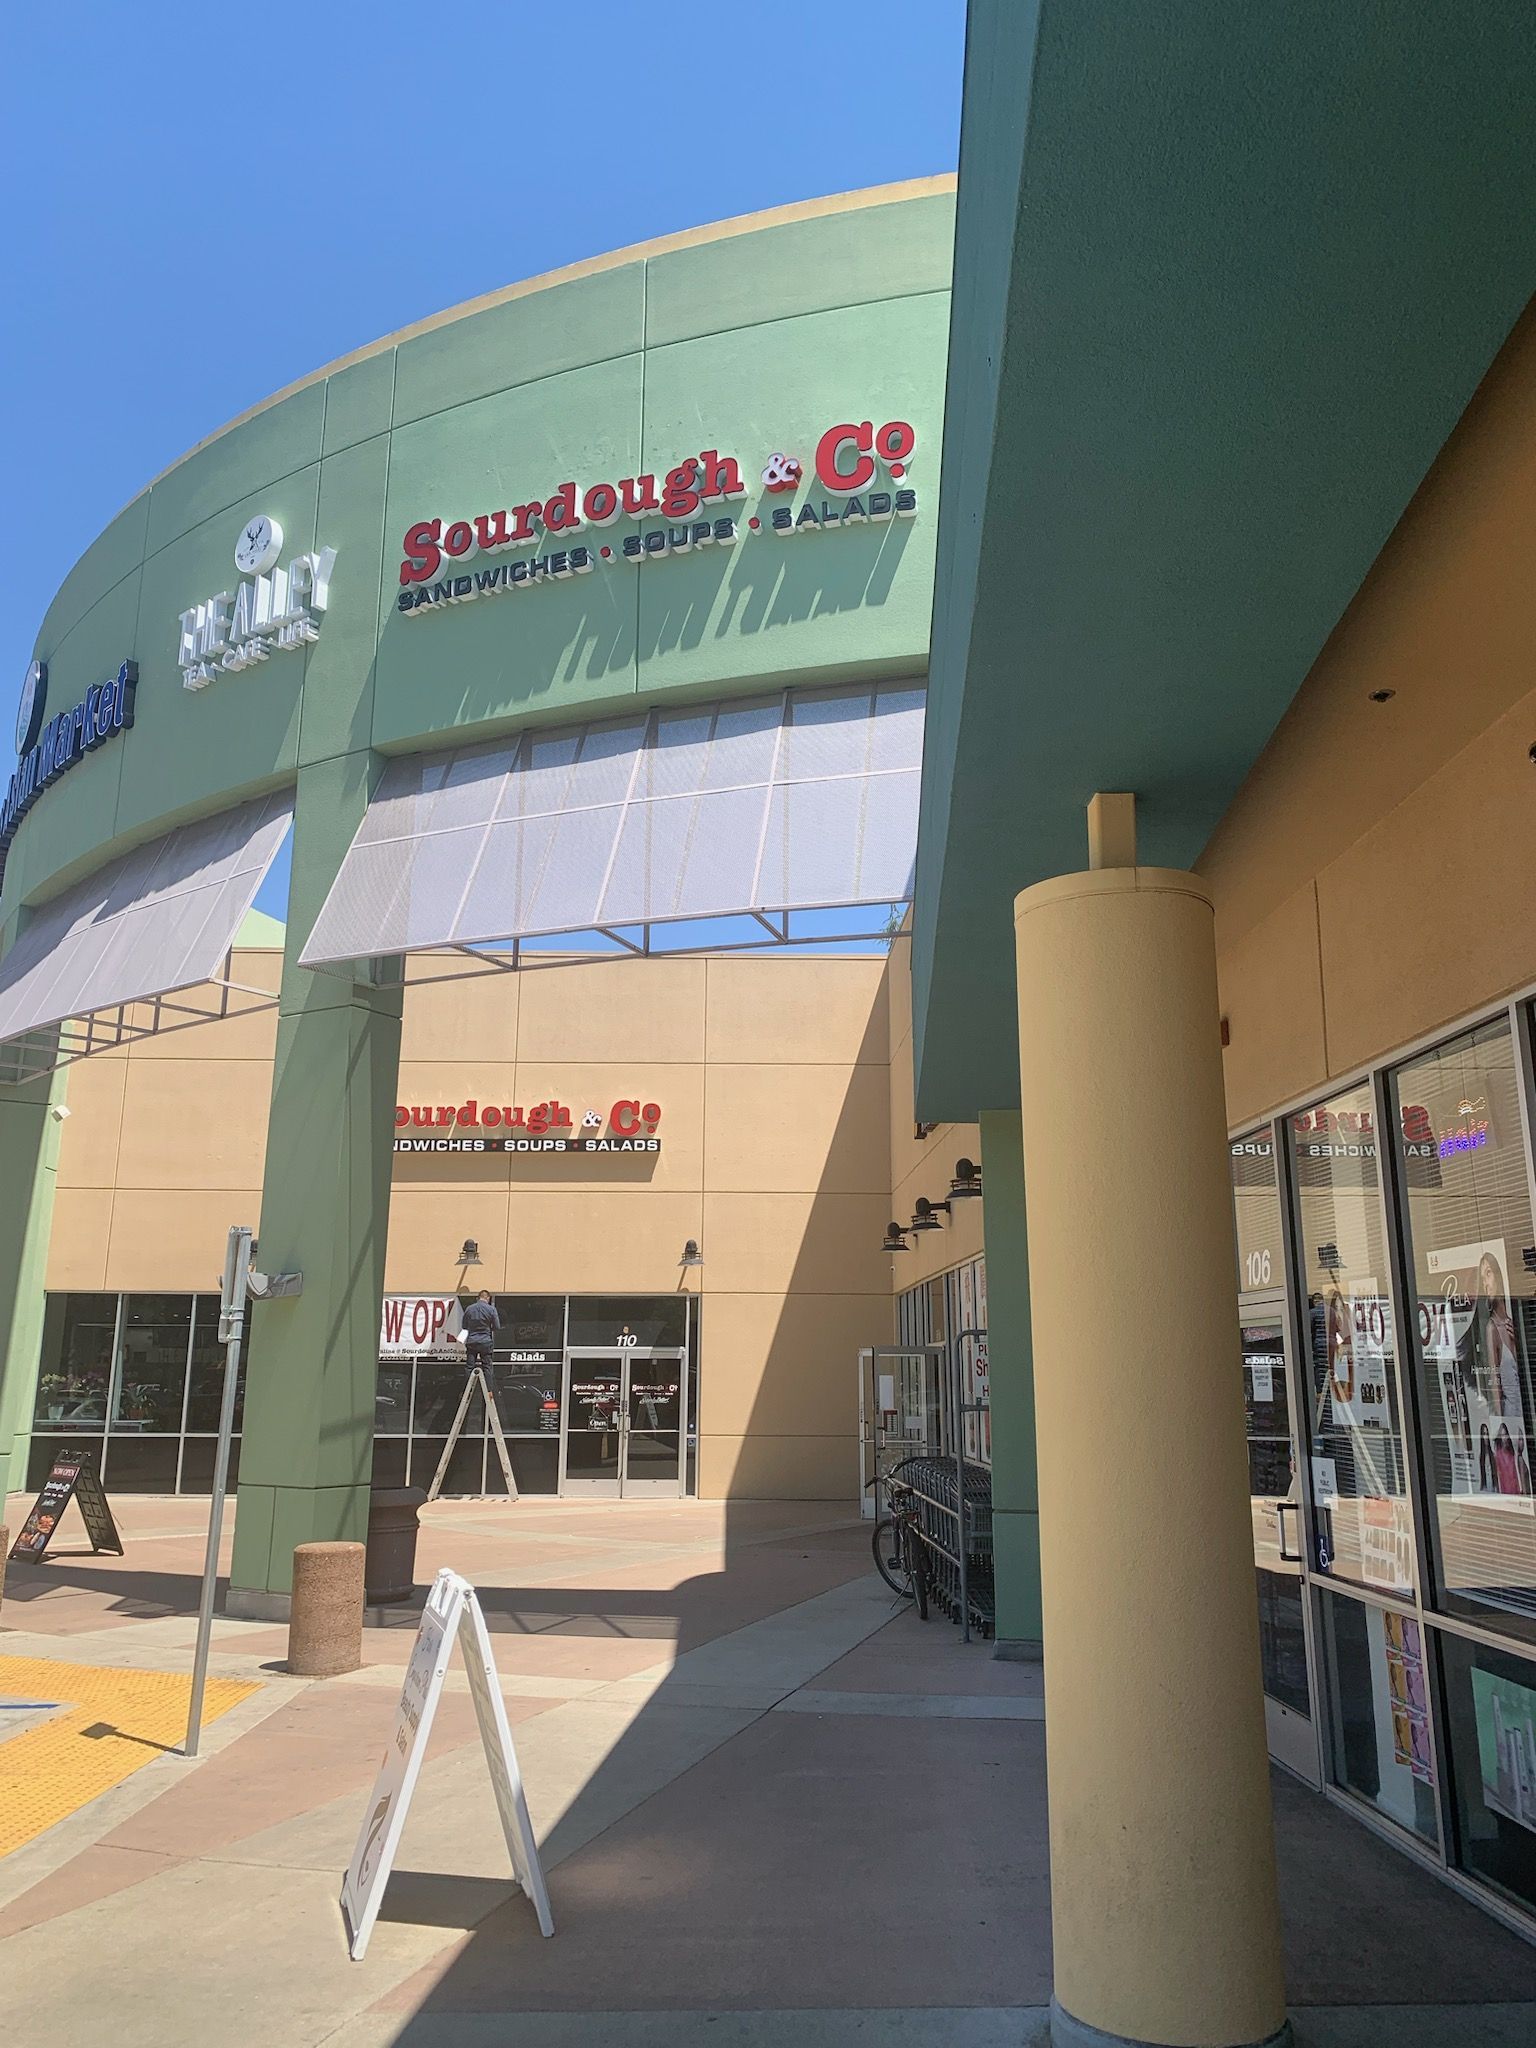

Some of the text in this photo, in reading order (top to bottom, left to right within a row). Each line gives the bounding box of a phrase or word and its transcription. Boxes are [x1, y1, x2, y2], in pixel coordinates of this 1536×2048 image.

[400, 449, 746, 586] Sourdough
[762, 452, 802, 493] &
[398, 488, 917, 612] SANDWICHES SOUPS SALADS
[36, 657, 138, 788] Market
[394, 1100, 573, 1135] ourdough
[580, 1109, 602, 1129] &
[393, 1139, 659, 1152] DWICHES SOUPS SALADS
[1246, 1249, 1271, 1286] 106
[616, 1334, 638, 1347] 110
[510, 1352, 546, 1361] Salads
[572, 1384, 605, 1392] Sourdough
[632, 1384, 665, 1392] Sourdough
